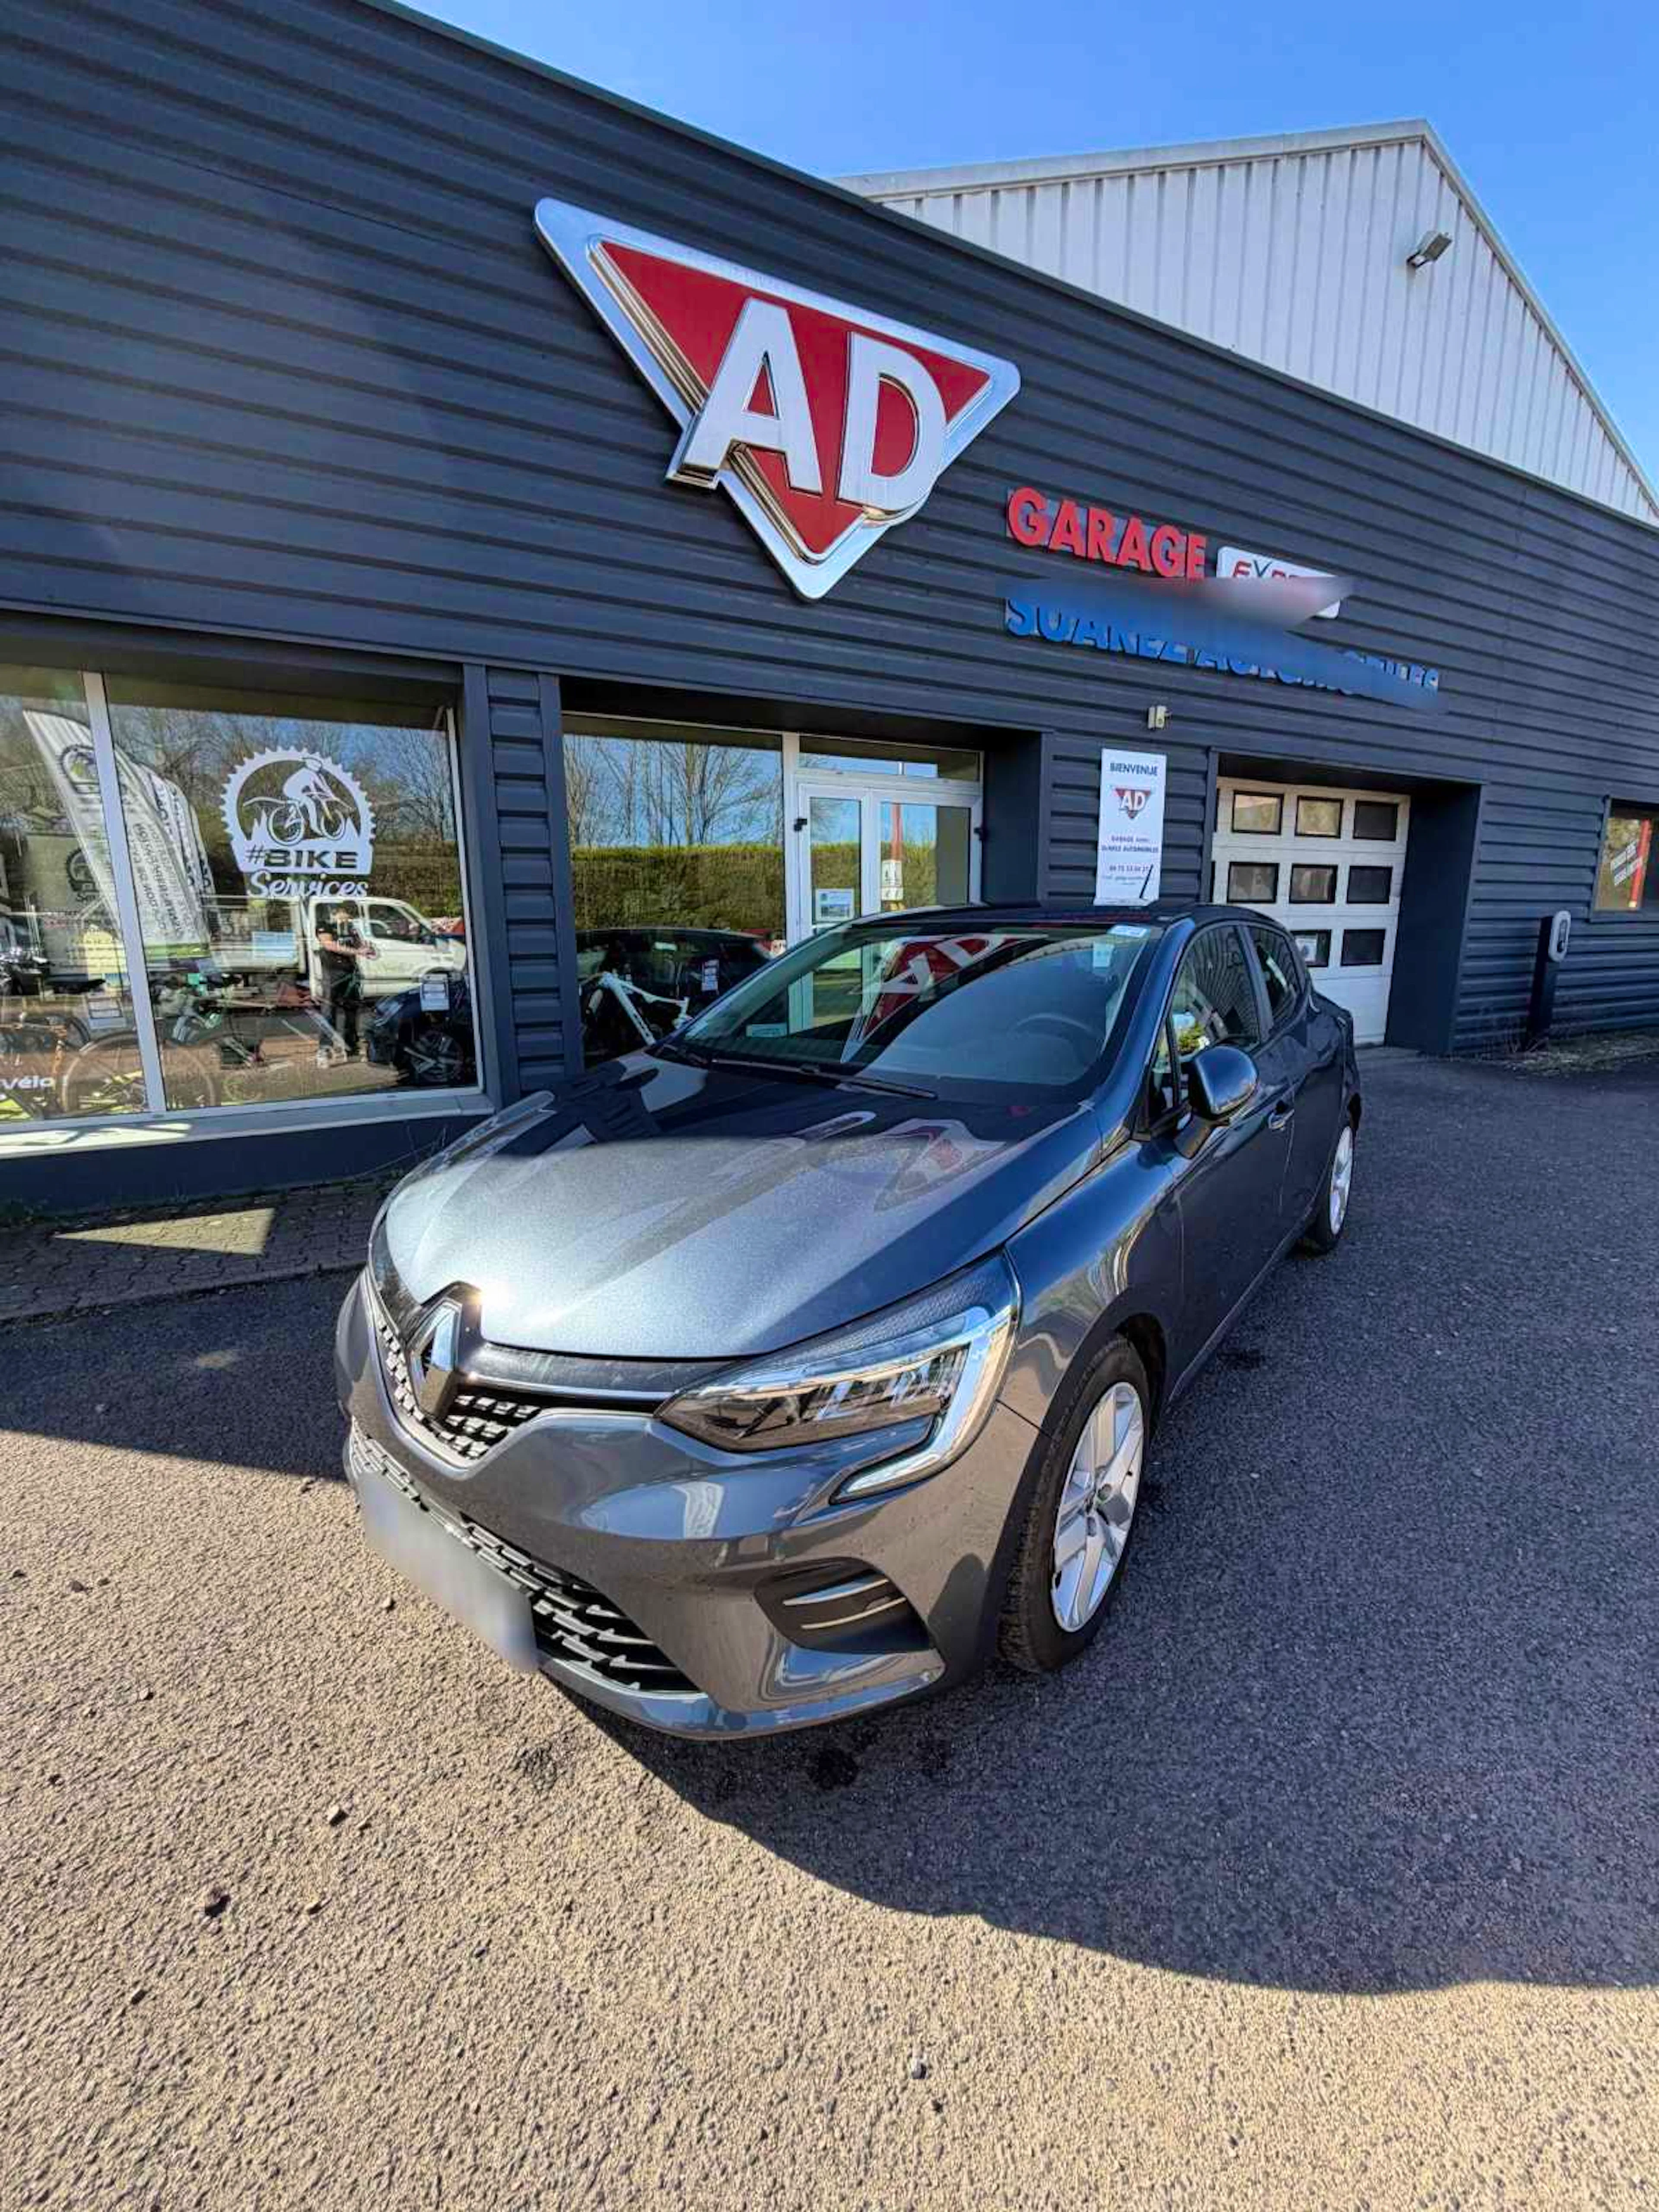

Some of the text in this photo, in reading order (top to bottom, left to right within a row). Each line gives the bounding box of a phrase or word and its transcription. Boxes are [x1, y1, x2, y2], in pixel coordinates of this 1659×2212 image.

[674, 296, 948, 514] AD
[1008, 486, 1207, 578] GARAGE
[1110, 762, 1158, 776] BIENVENUE
[1120, 789, 1146, 811] AD
[245, 844, 359, 868] #BIKE
[247, 869, 369, 898] Services
